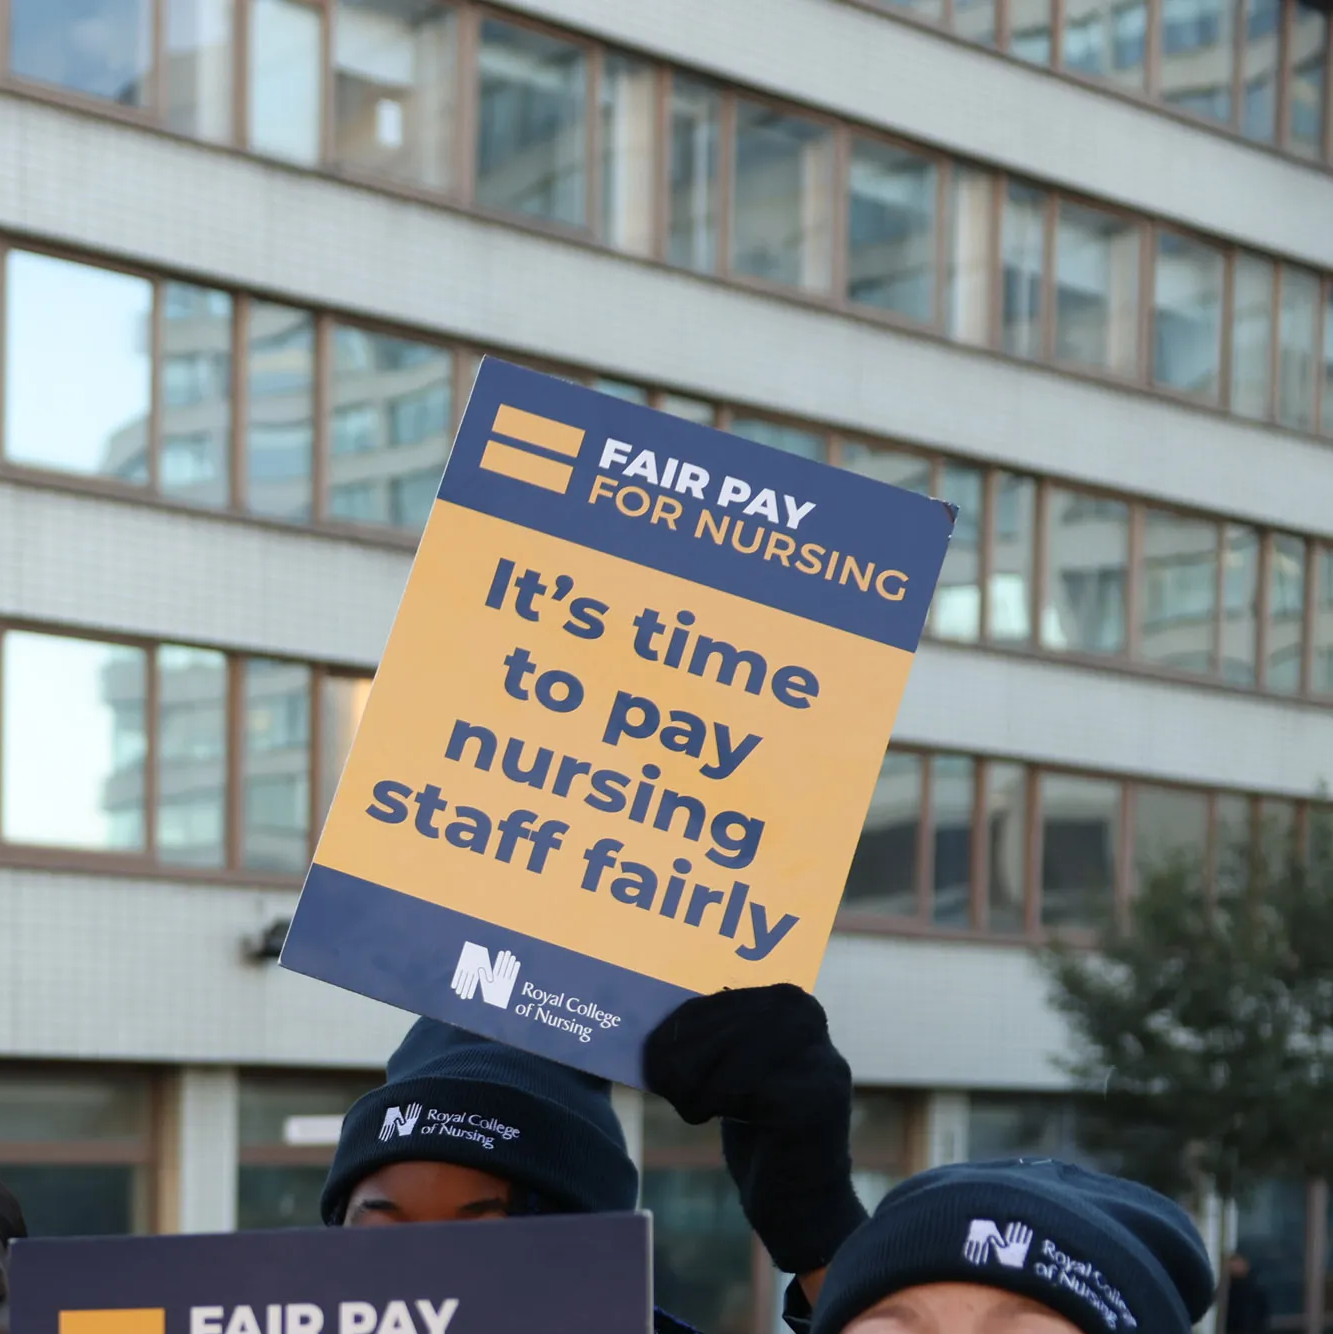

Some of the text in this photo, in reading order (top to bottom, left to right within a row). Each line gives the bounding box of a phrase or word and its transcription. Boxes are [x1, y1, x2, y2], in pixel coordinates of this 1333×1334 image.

[598, 438, 817, 530] FAIR PAY
[587, 478, 910, 602] FOR NURSING
[484, 557, 821, 710] It's time
[503, 647, 764, 780] to pay
[444, 718, 766, 869] nursing
[365, 777, 800, 961] staff fairly
[515, 1003, 593, 1043] of Nursing
[521, 981, 622, 1029] Royal College
[421, 1122, 496, 1150] of Nursing
[427, 1108, 521, 1140] Royal College
[1034, 1262, 1058, 1280] of
[1041, 1238, 1093, 1278] Royal
